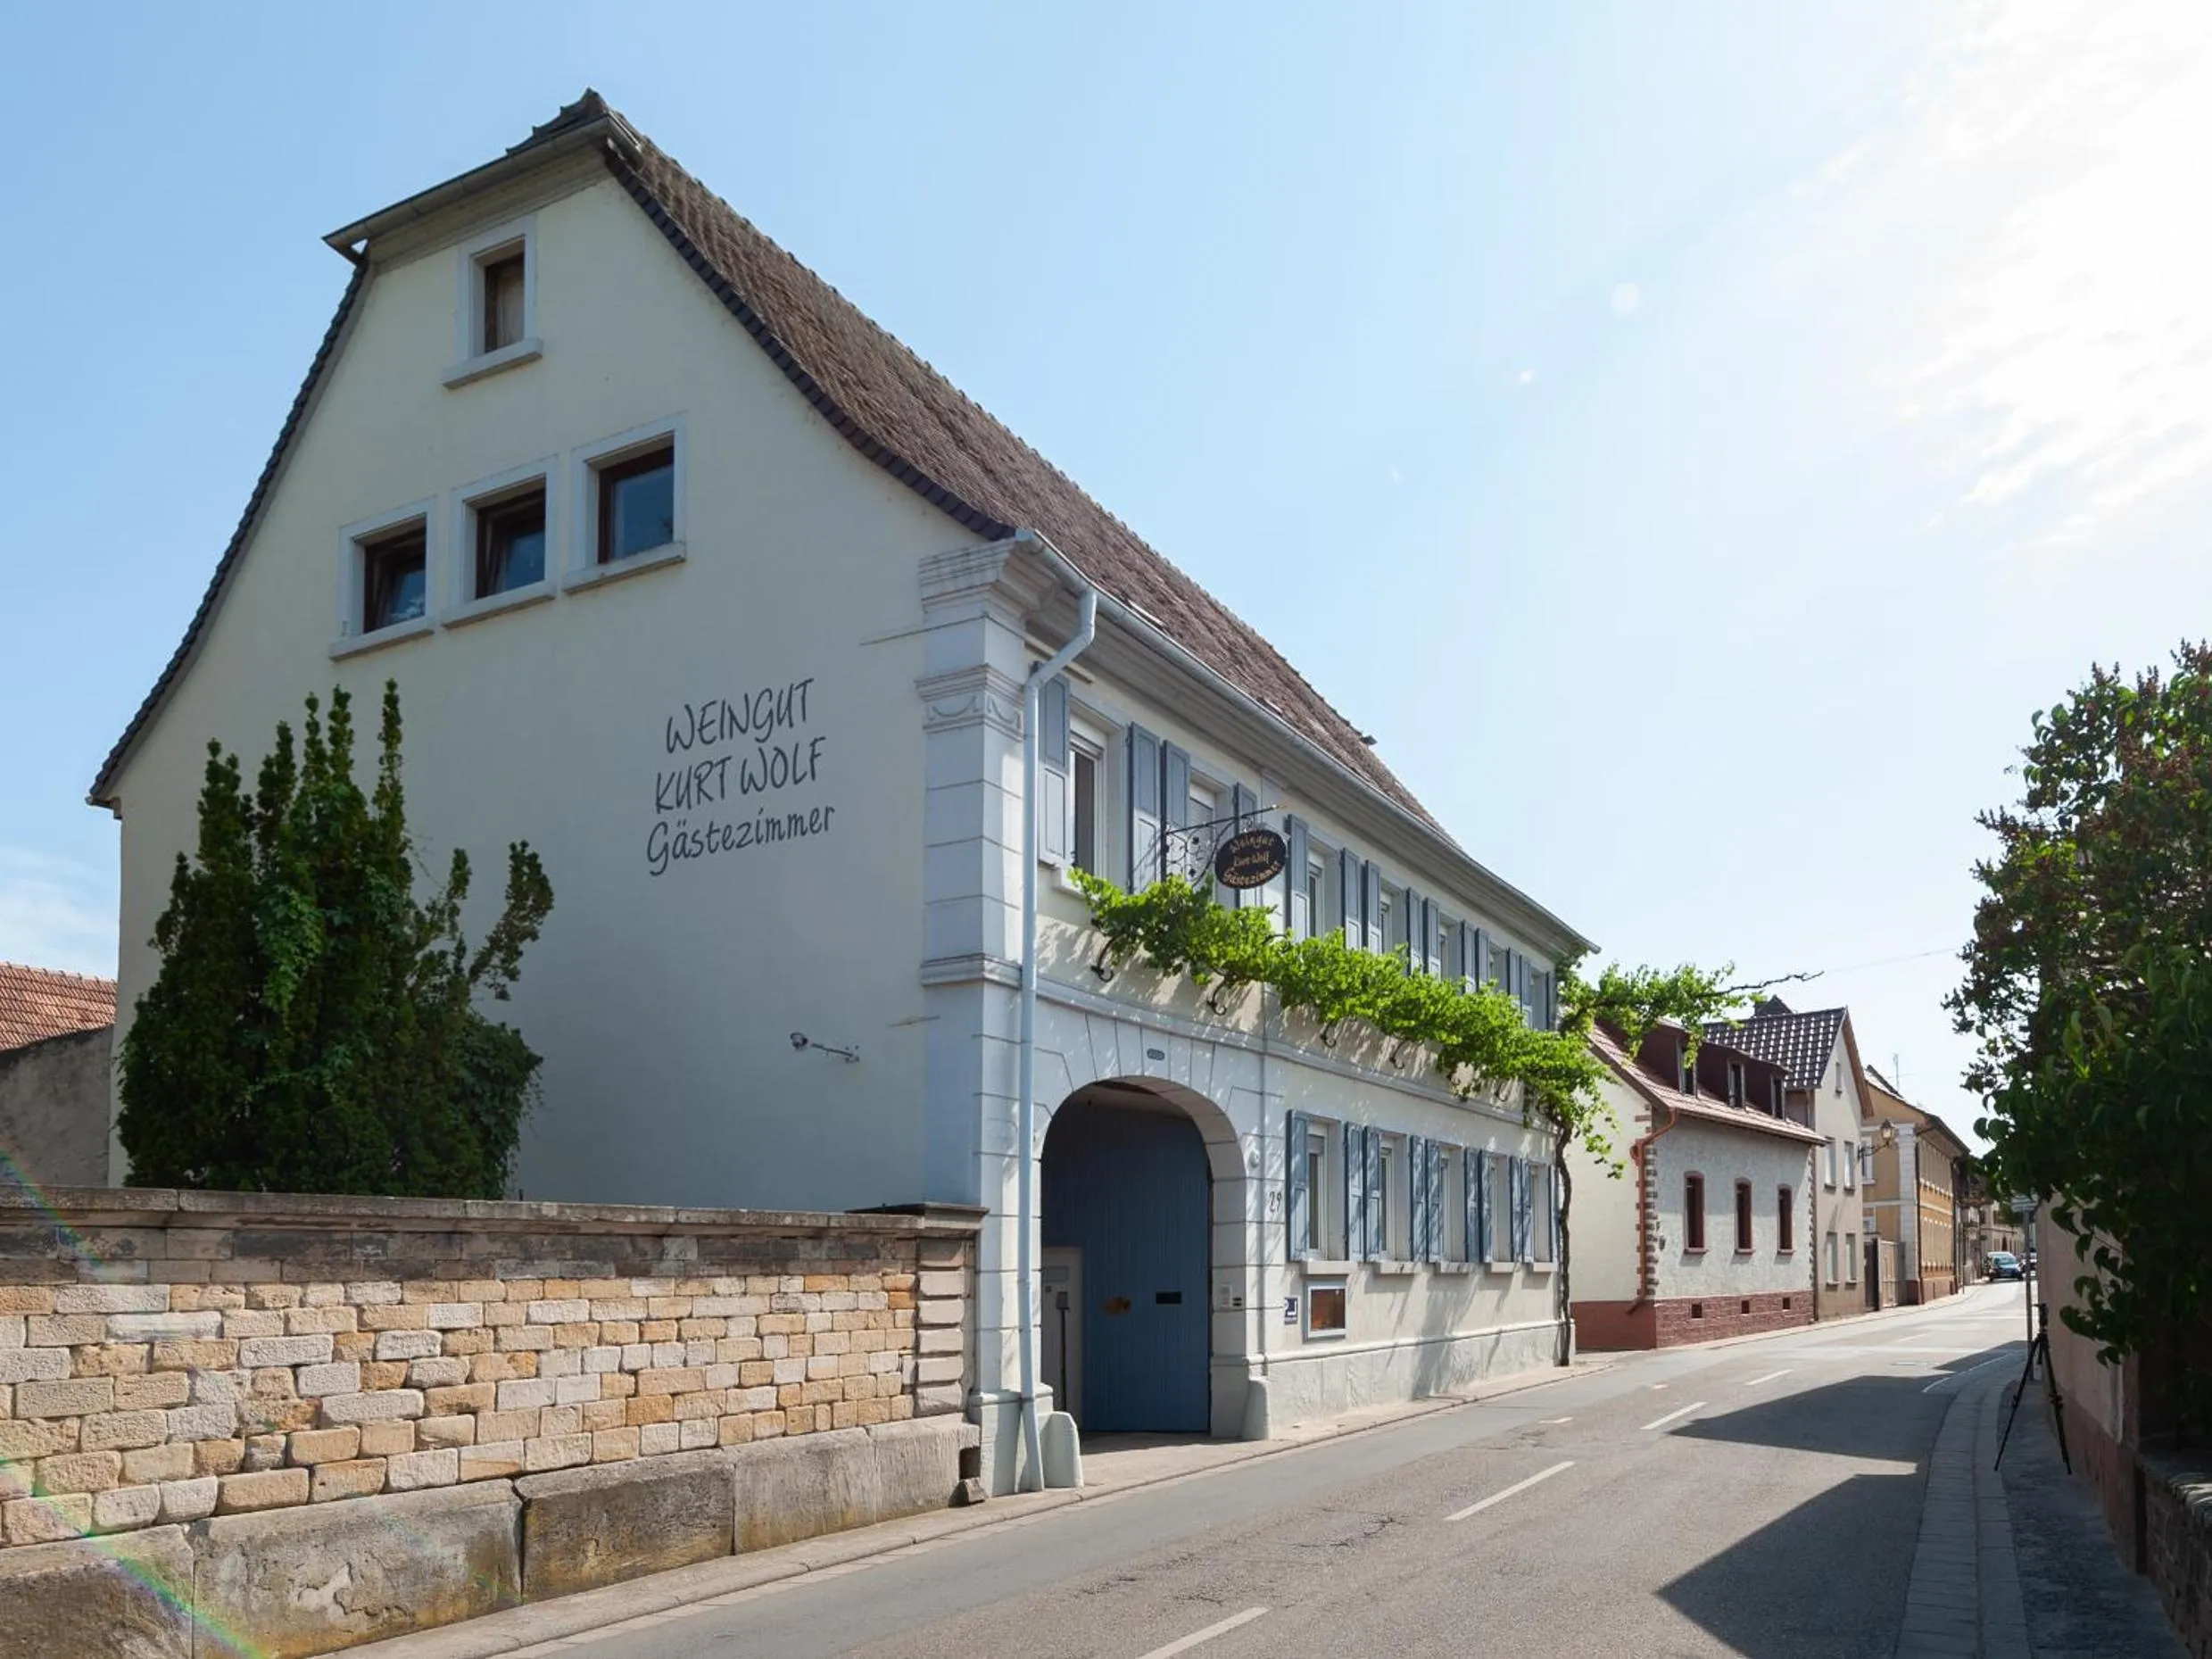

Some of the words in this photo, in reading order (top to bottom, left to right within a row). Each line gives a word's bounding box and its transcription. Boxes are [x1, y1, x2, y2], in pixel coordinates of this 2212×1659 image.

[667, 678, 814, 753] WEINGUT
[656, 755, 733, 814] KURT
[740, 736, 826, 795] WOLF
[647, 807, 835, 876] Gästezimmer
[1269, 1191, 1282, 1213] 29
